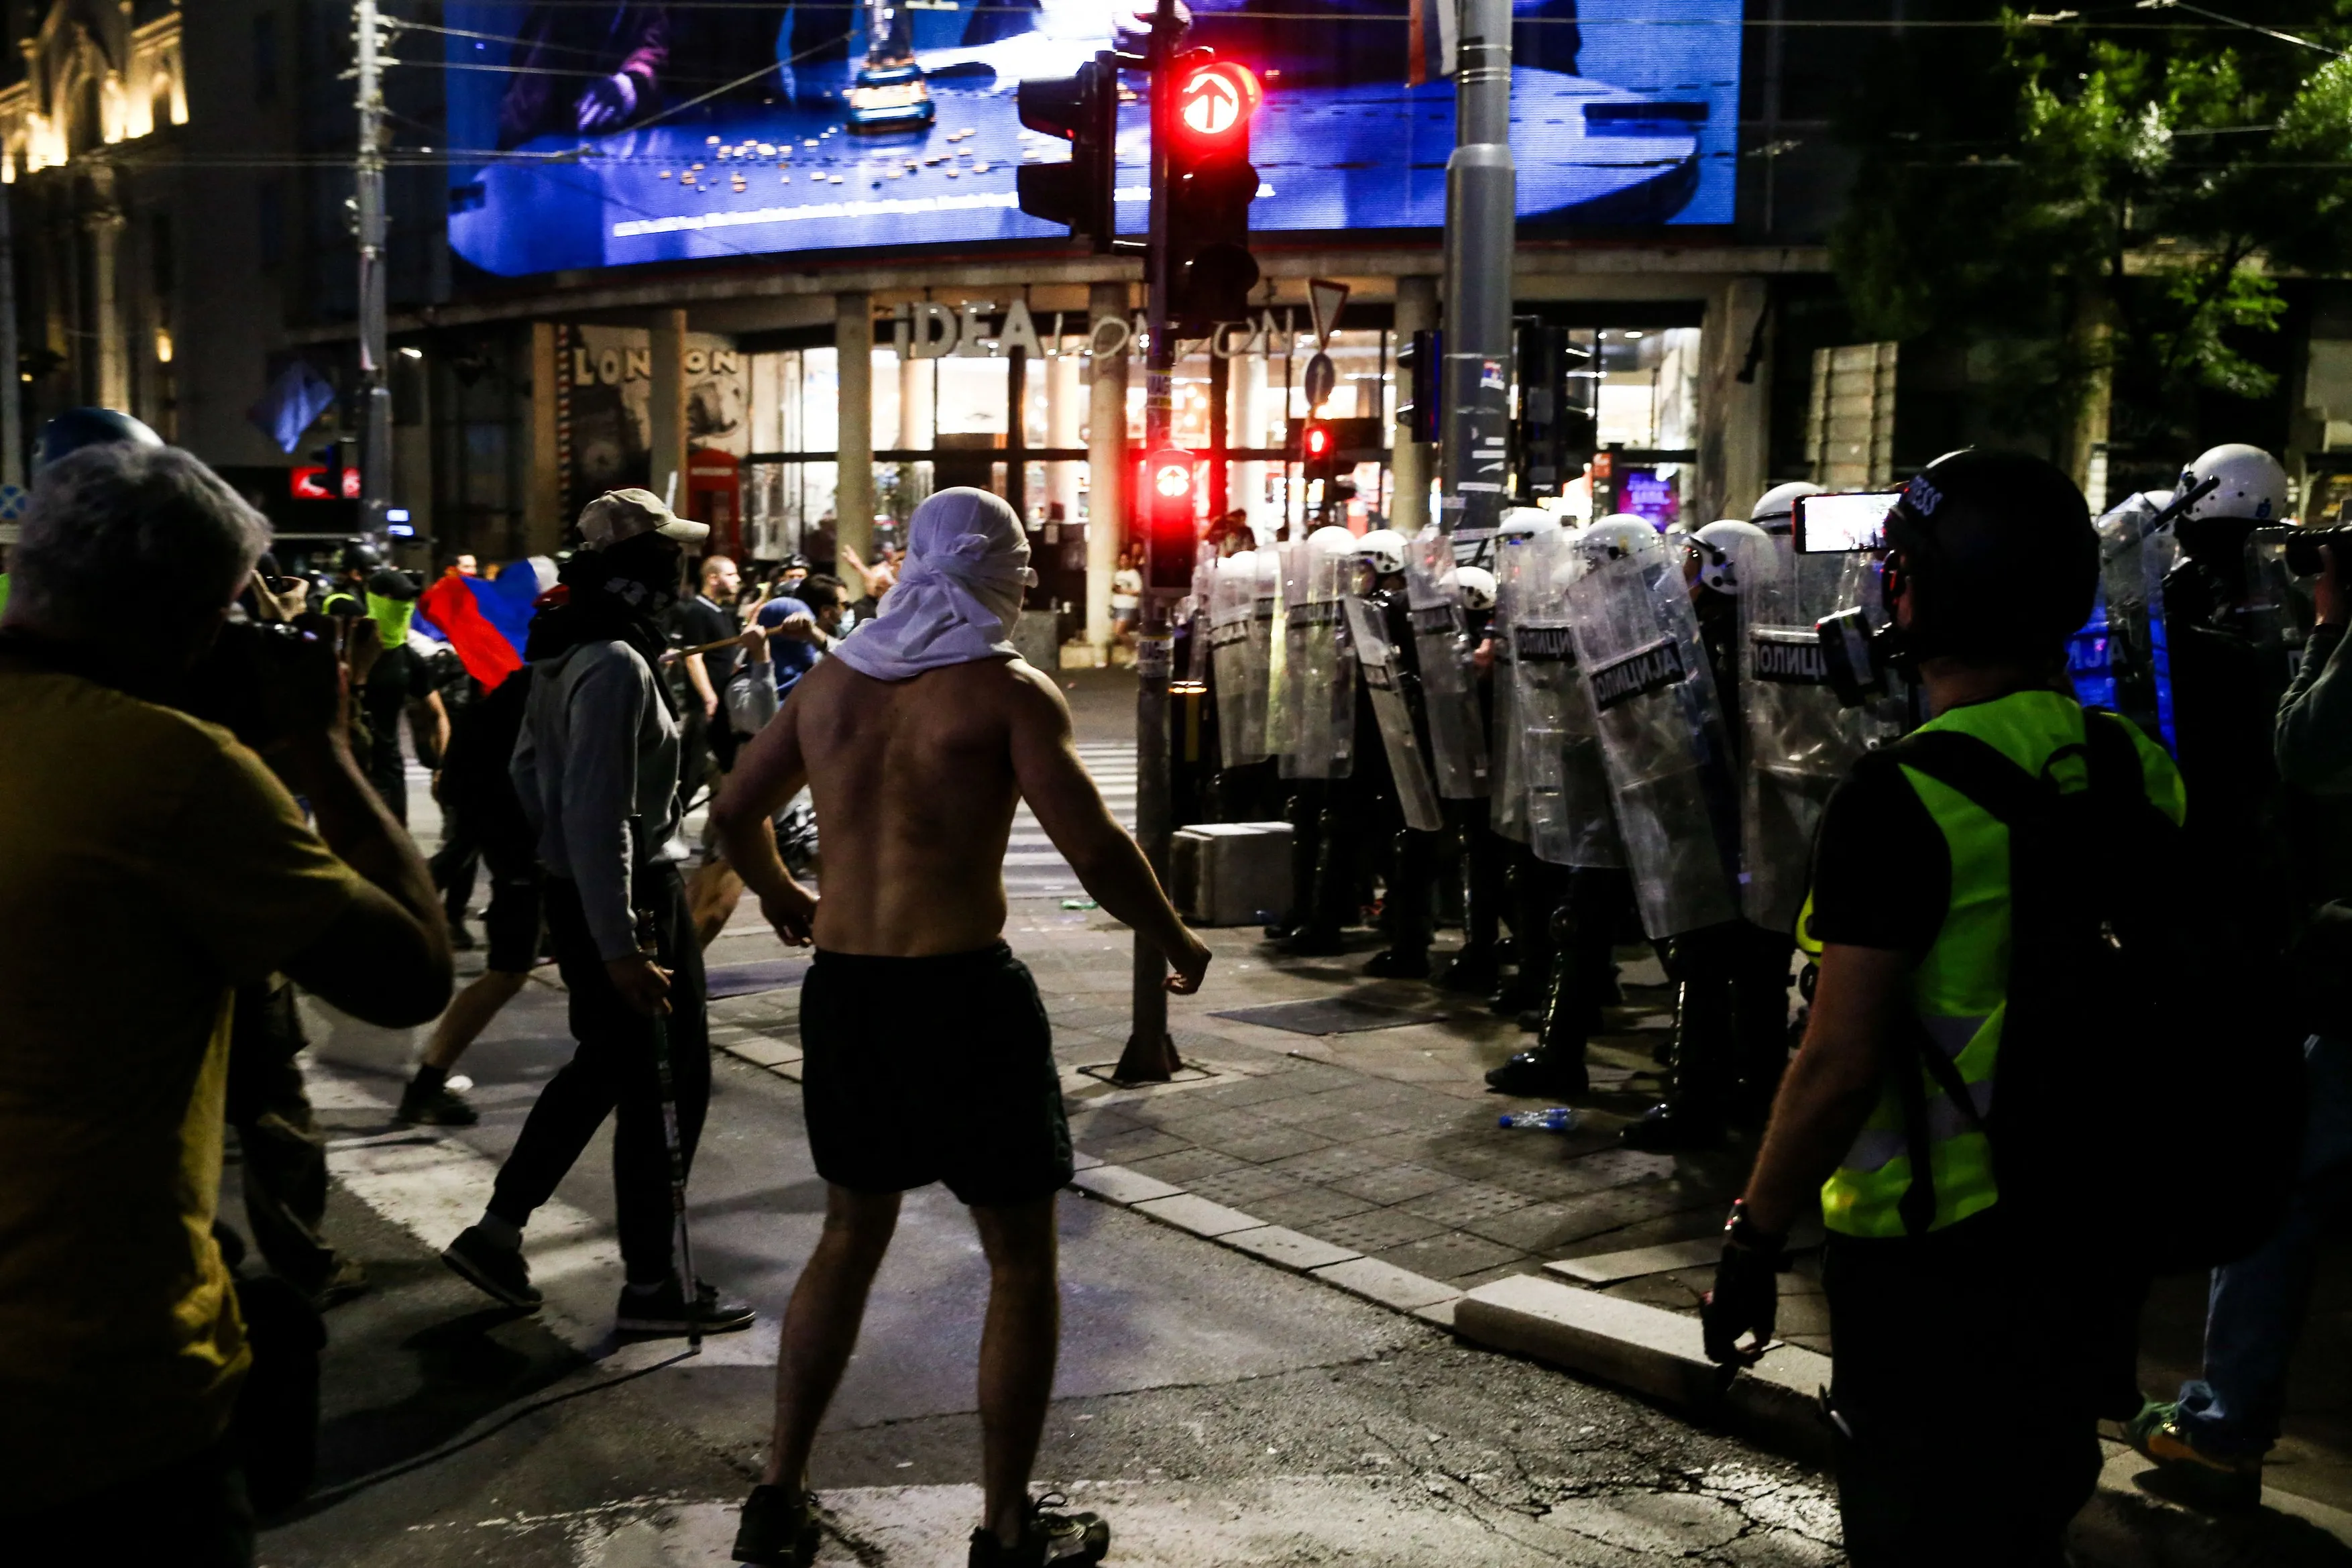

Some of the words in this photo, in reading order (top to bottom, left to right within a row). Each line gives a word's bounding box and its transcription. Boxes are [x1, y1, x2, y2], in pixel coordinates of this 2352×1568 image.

[1054, 307, 1295, 360] LOON
[573, 347, 738, 386] LONON
[1594, 647, 1681, 703] ОЛИЦИЈА
